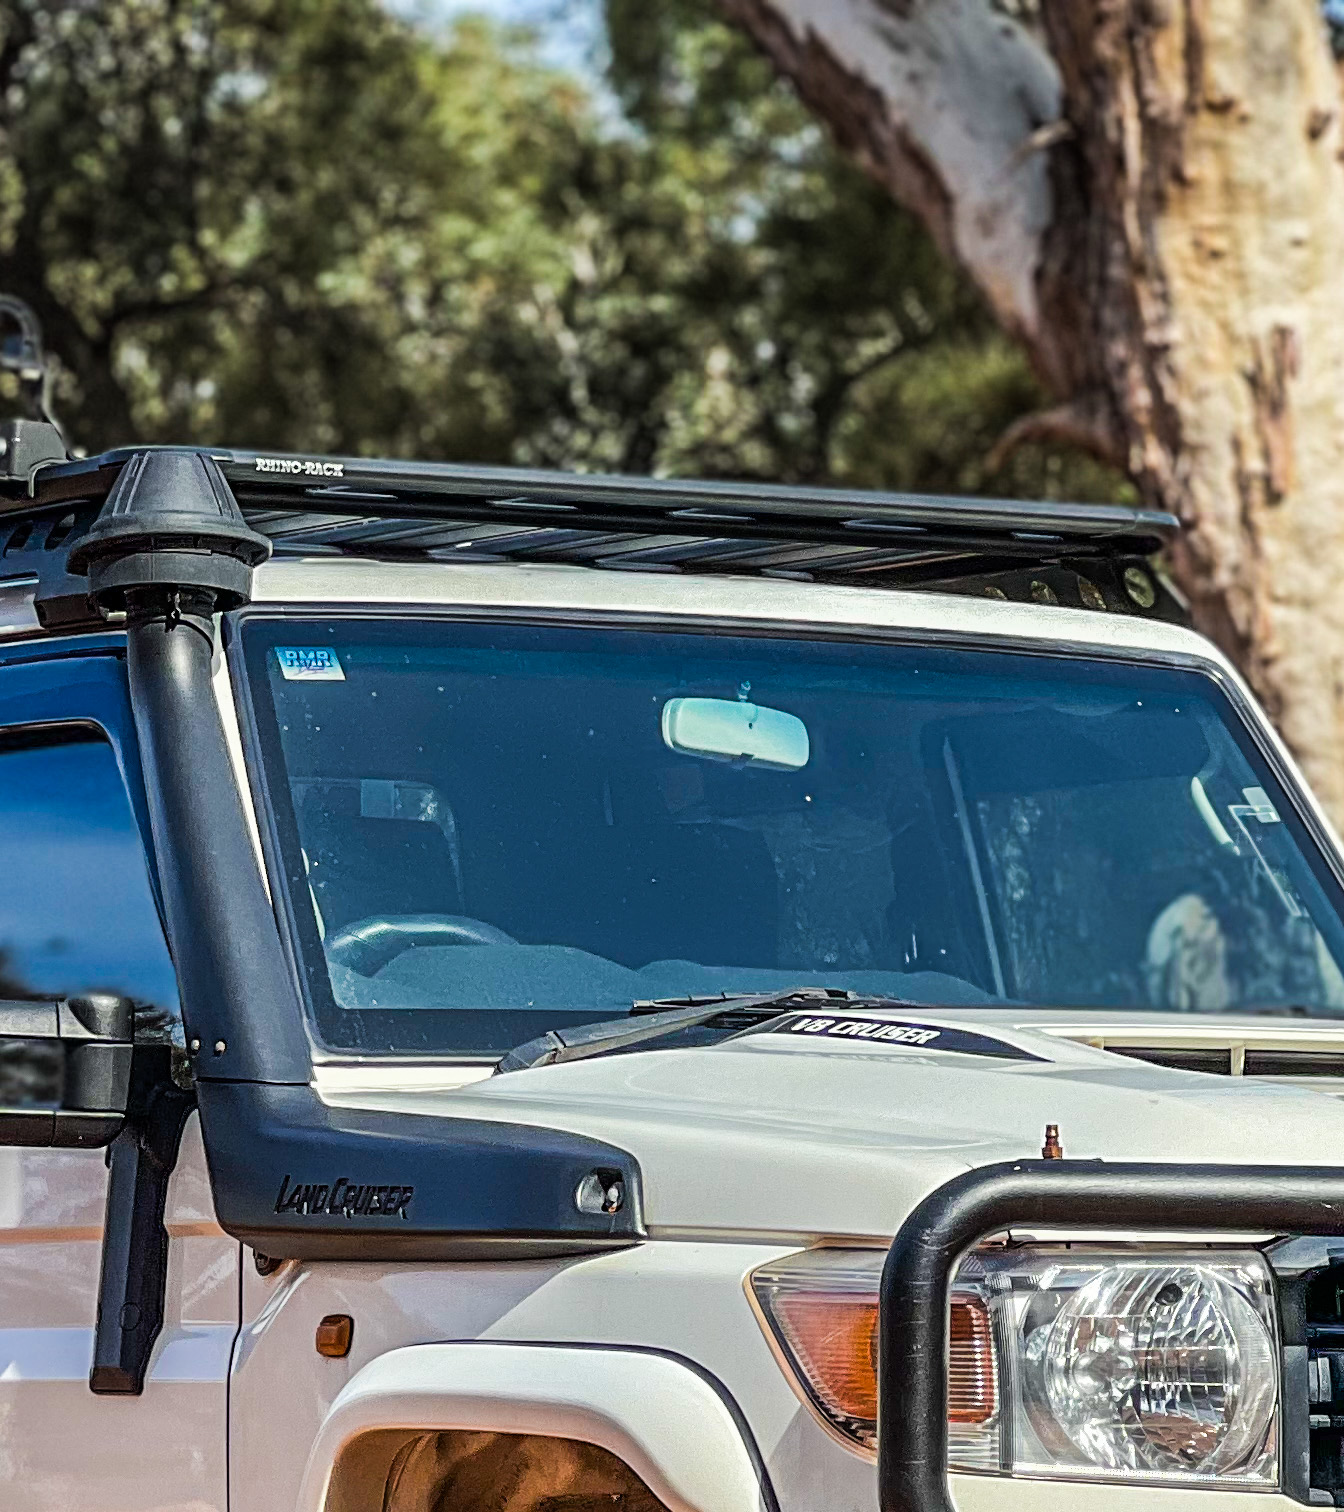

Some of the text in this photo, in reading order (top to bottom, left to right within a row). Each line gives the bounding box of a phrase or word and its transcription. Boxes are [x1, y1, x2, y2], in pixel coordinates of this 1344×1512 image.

[255, 457, 344, 477] RHINO-RACK
[791, 1018, 941, 1045] V8 CRUISER
